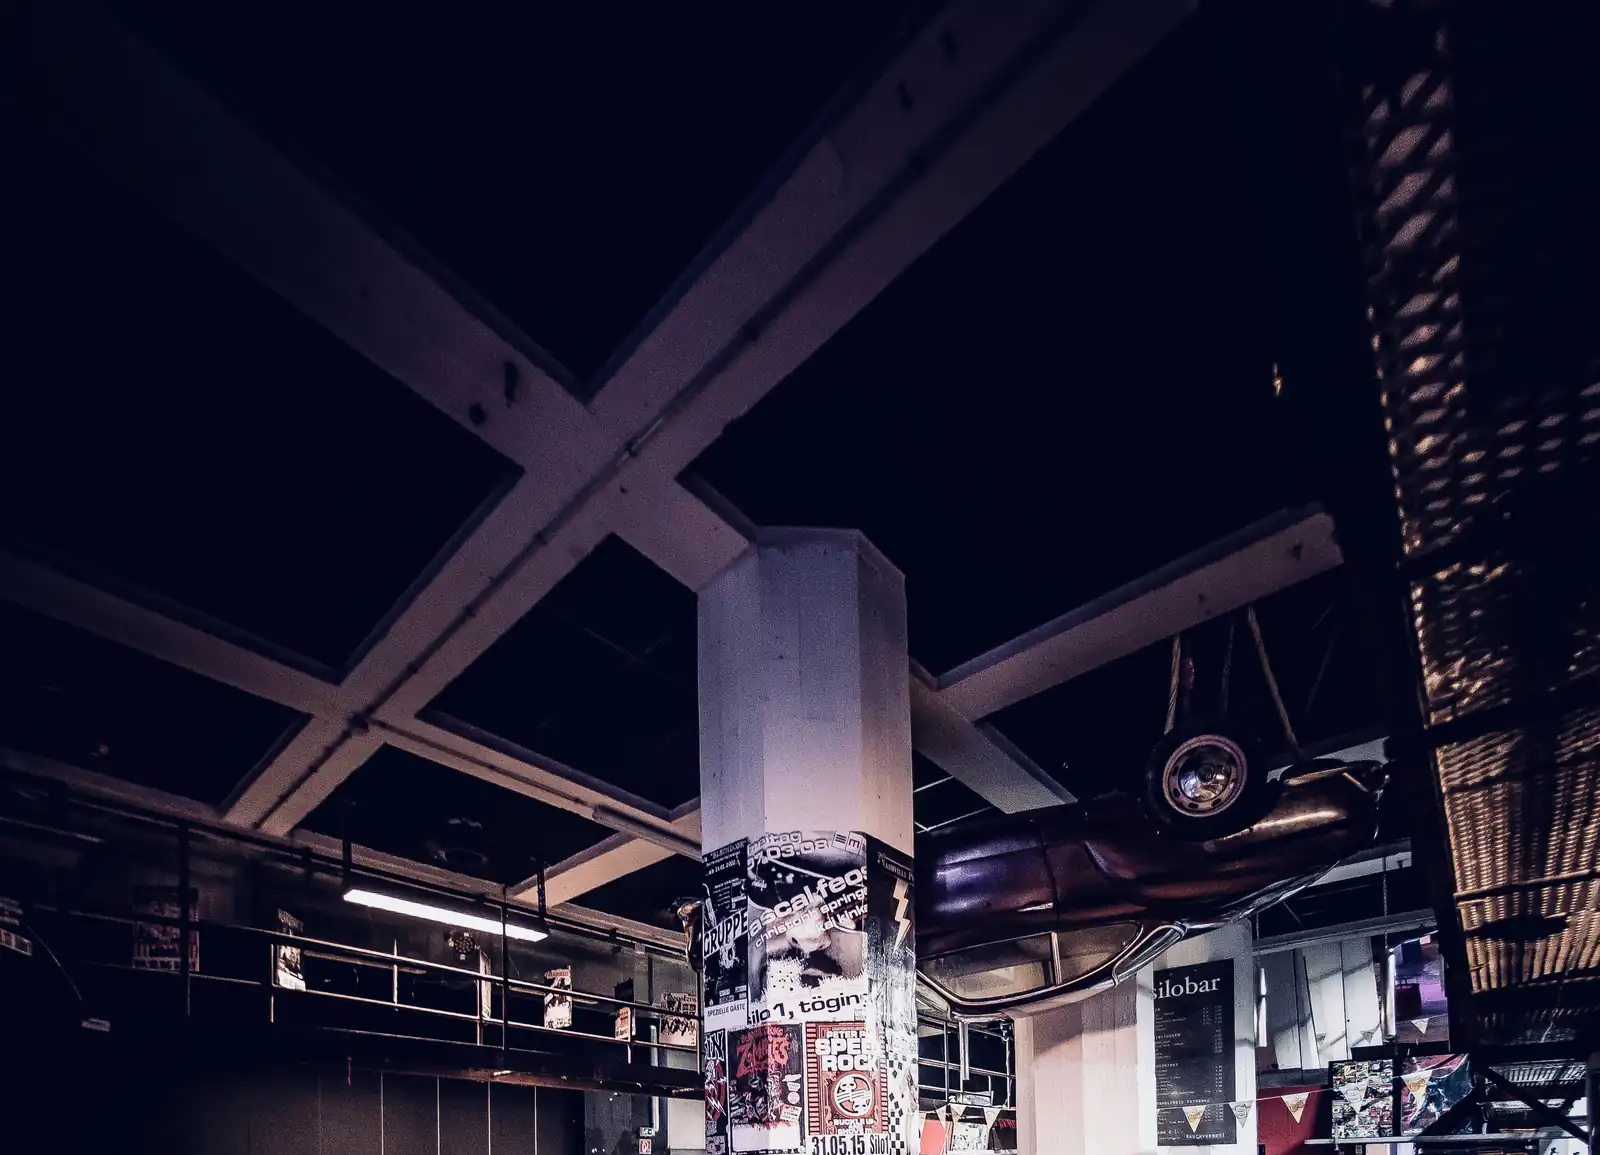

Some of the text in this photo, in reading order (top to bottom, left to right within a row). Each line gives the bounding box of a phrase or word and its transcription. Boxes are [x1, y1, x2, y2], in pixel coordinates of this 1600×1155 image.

[747, 885, 814, 940] ascal
[703, 910, 748, 957] GRUPPE
[755, 908, 819, 948] christoph
[1152, 976, 1221, 1000] silobar
[707, 1002, 746, 1018] SPEZIELLE GÄSTE
[798, 993, 868, 1013] tögin
[826, 1030, 858, 1039] PETER
[821, 1054, 879, 1071] ROCK
